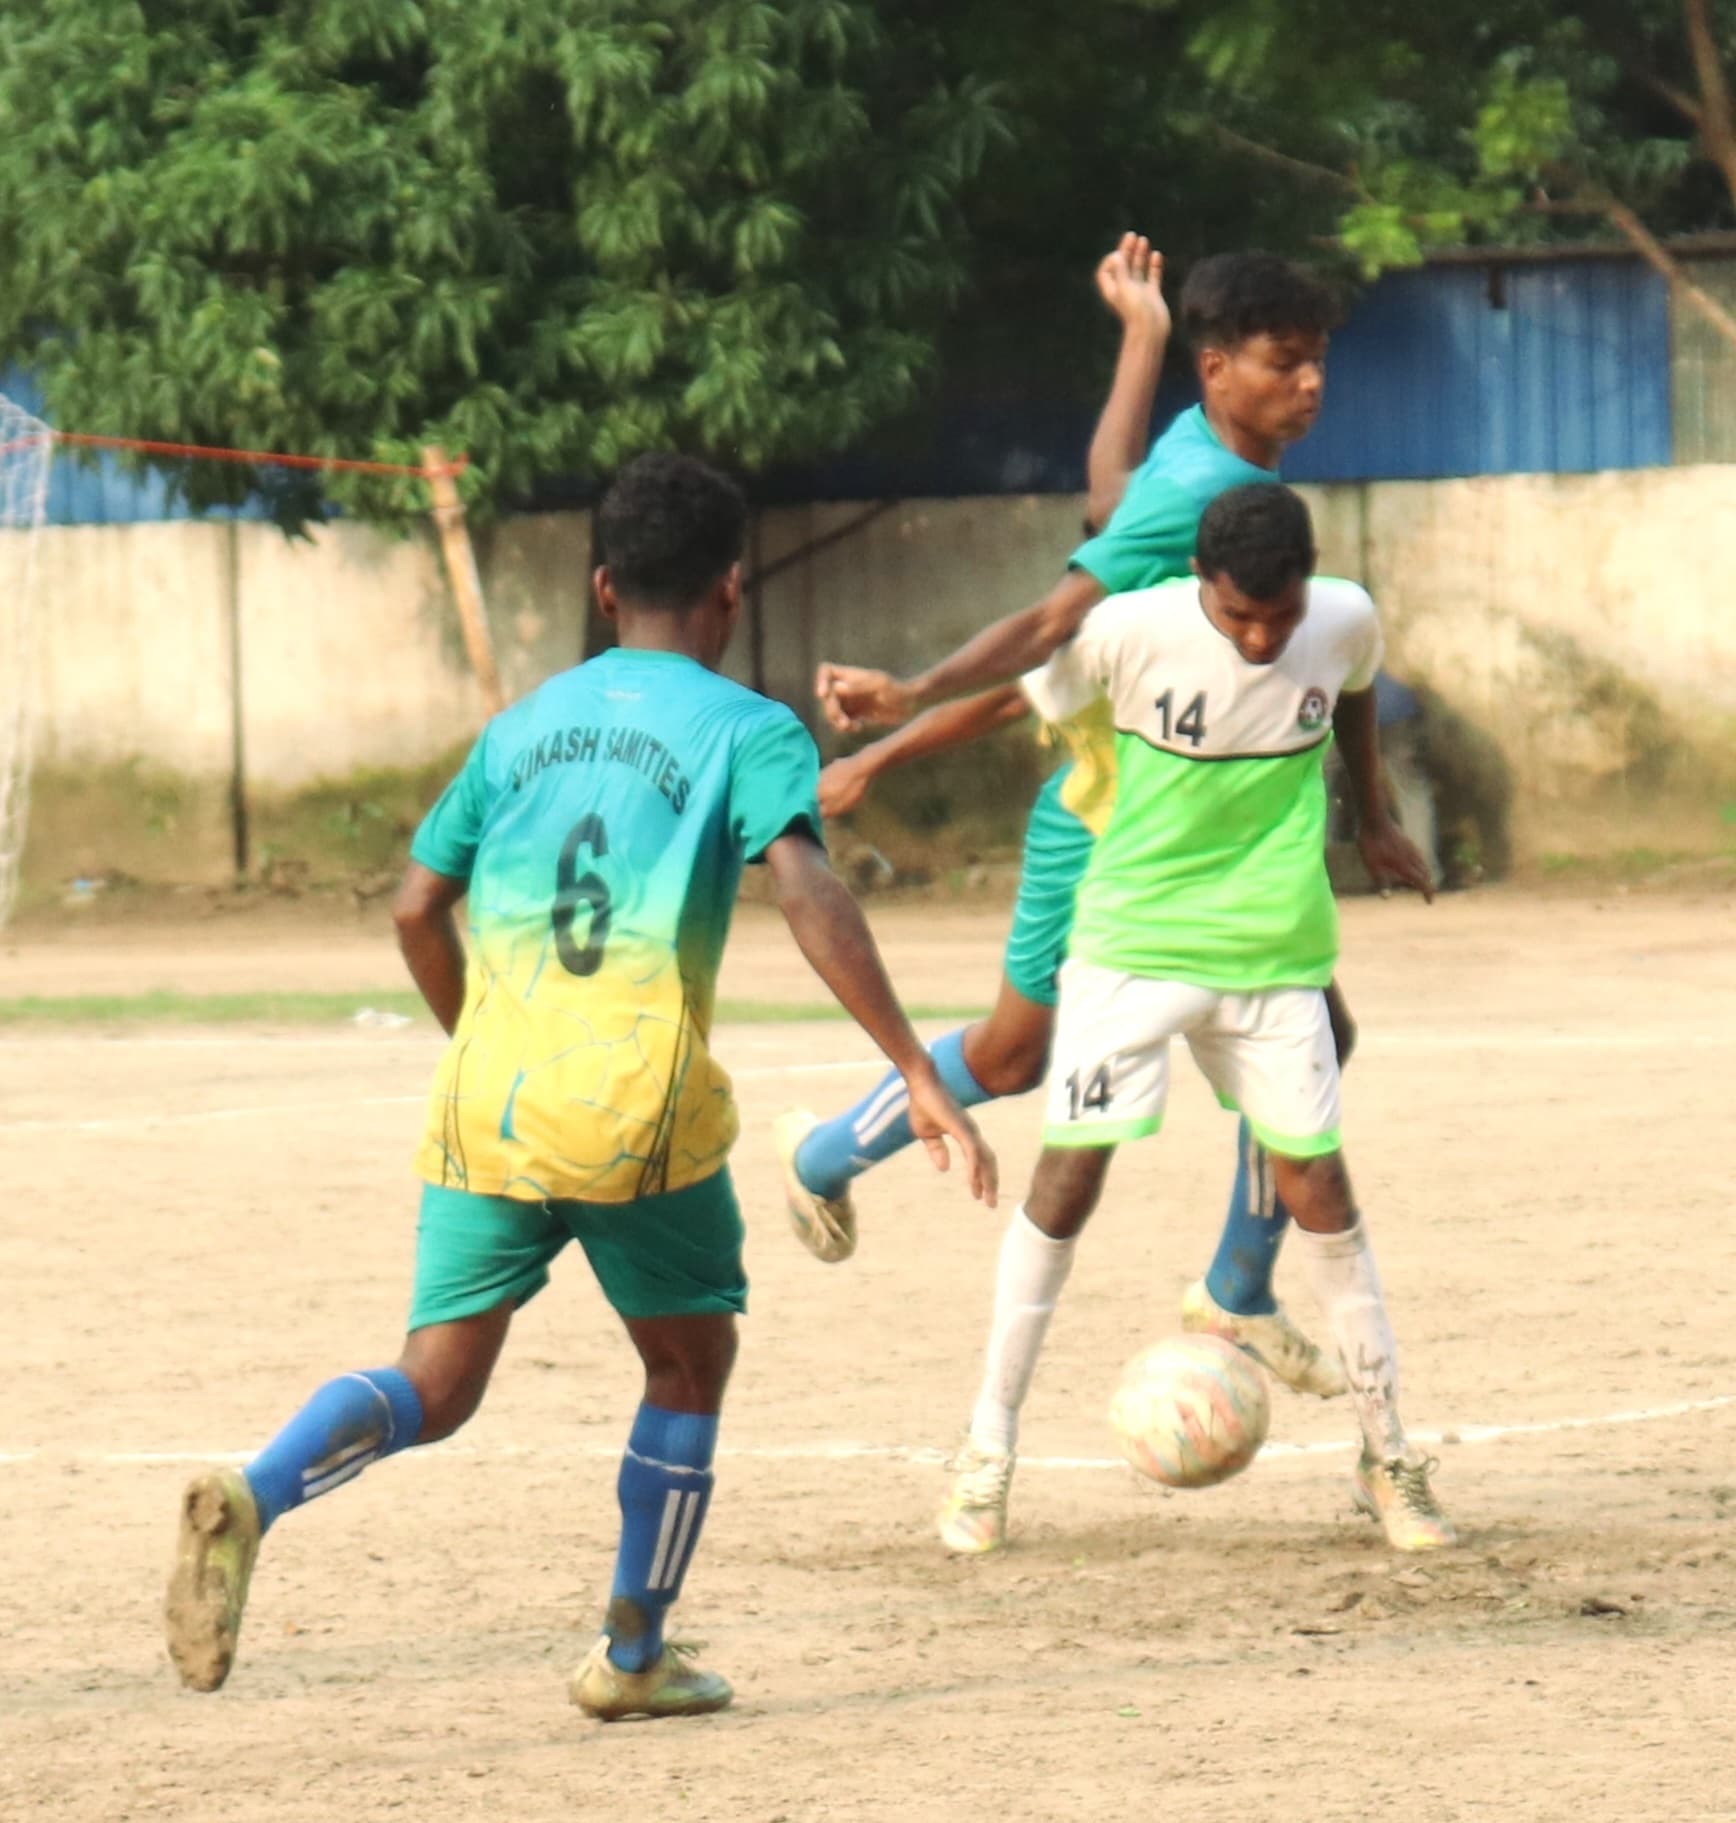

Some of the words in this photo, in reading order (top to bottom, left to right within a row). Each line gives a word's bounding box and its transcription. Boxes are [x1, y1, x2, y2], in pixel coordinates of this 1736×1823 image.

[1155, 687, 1208, 747] 14
[552, 812, 612, 977] 6
[1065, 1063, 1114, 1121] 14
